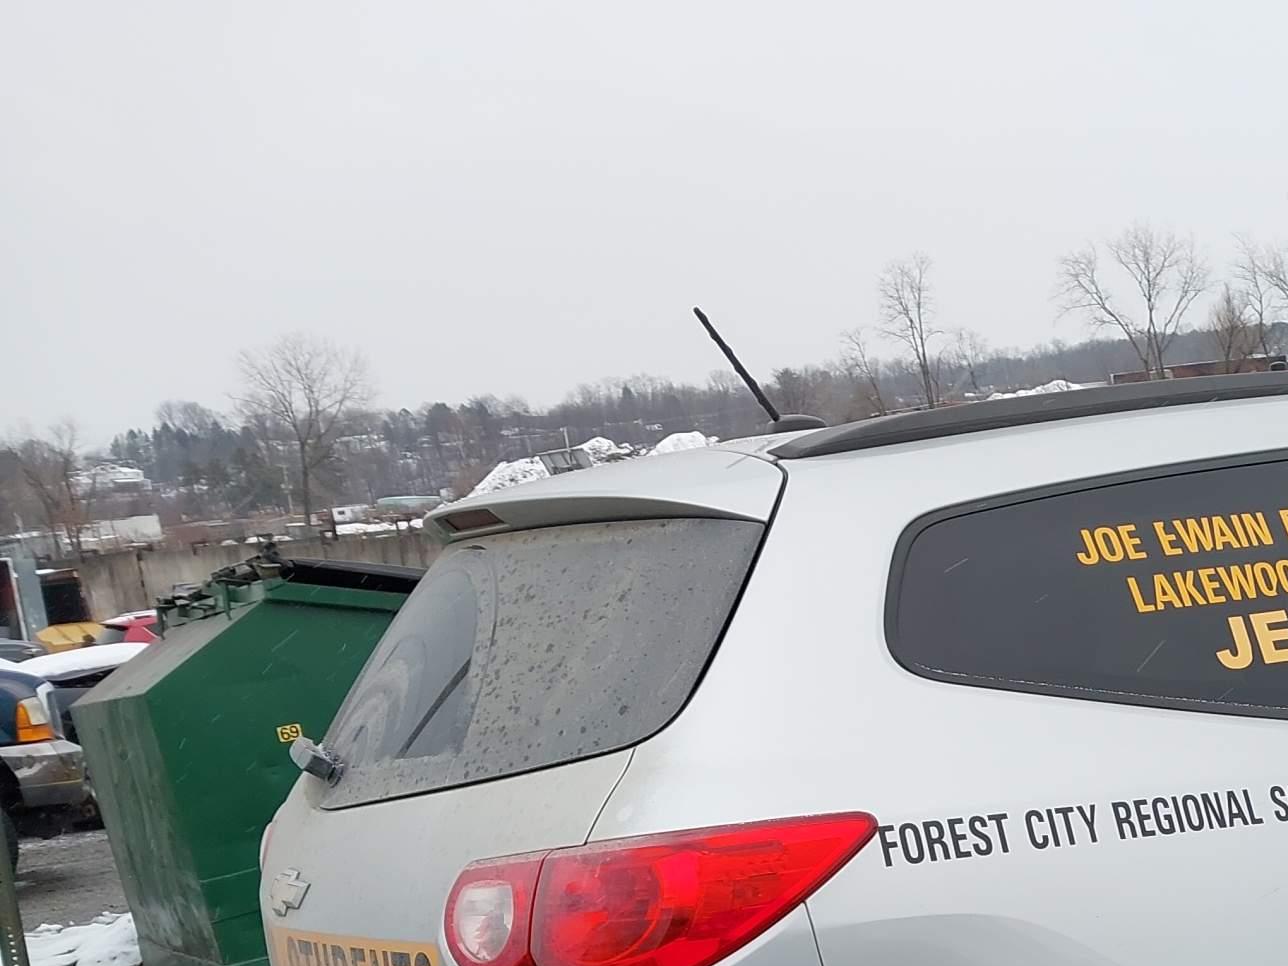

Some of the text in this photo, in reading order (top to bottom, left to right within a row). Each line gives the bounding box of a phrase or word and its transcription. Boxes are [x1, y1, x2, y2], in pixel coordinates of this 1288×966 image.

[1077, 524, 1147, 565] JOE
[1154, 512, 1273, 556] EWAIN
[281, 725, 299, 740] 69
[879, 812, 1010, 867] FOREST
[1024, 804, 1099, 849] CITY
[1111, 790, 1264, 839] REGIONAL
